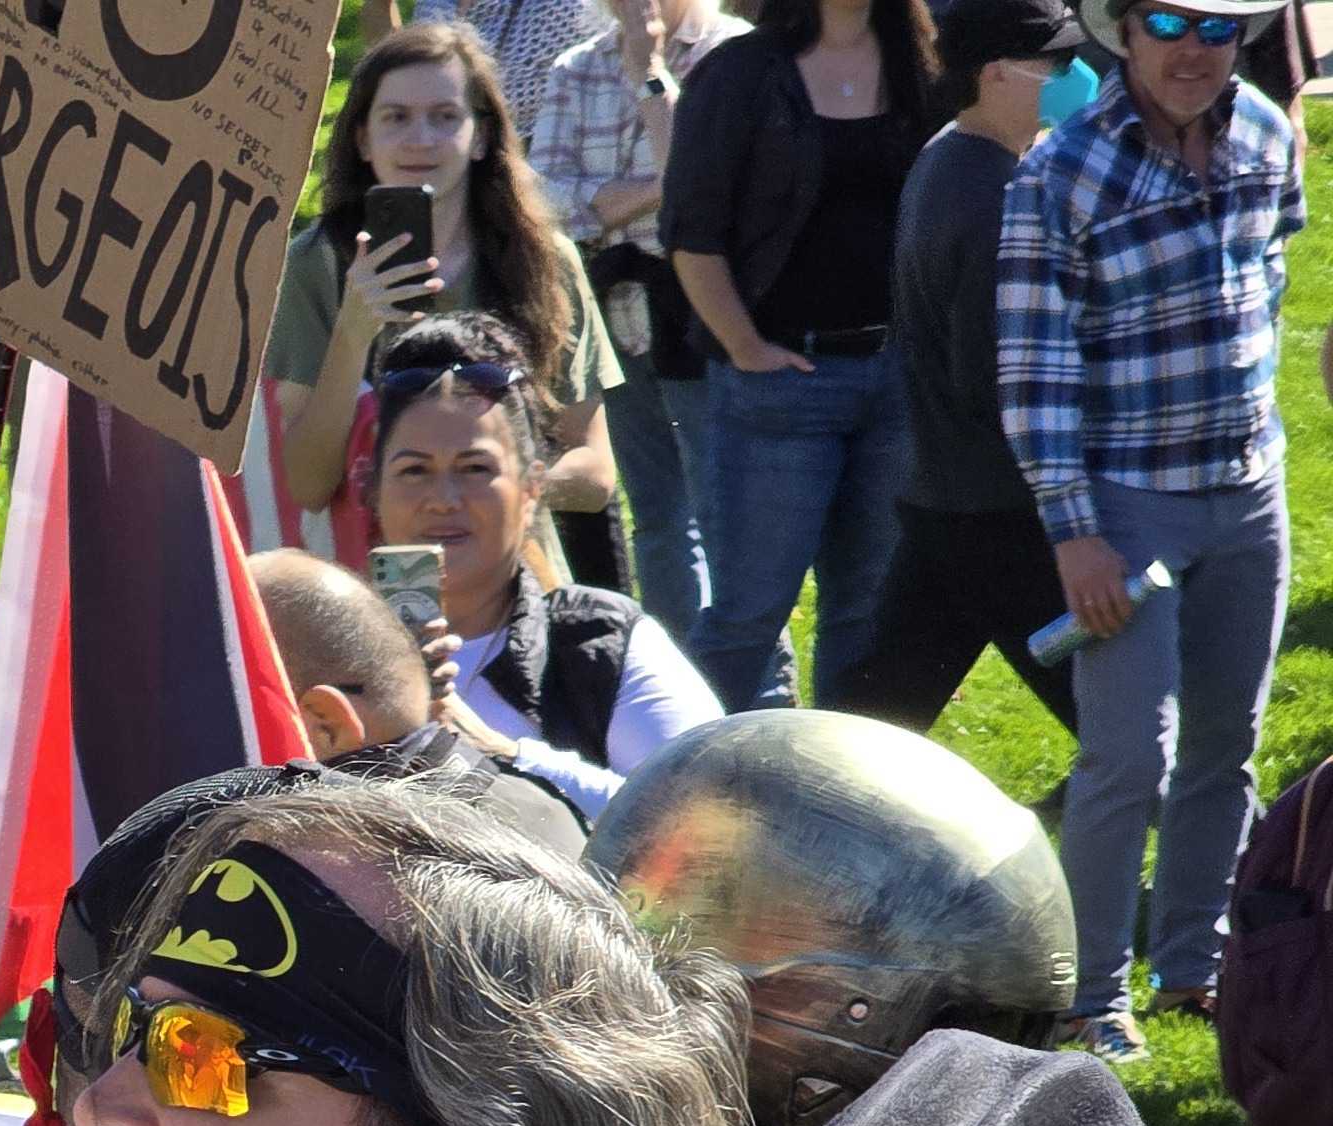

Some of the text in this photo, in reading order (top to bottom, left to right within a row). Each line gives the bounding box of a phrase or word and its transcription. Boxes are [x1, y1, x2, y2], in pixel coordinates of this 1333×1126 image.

[268, 32, 302, 63] ALL
[246, 85, 285, 120] ALL
[191, 101, 273, 159] NO SECRET
